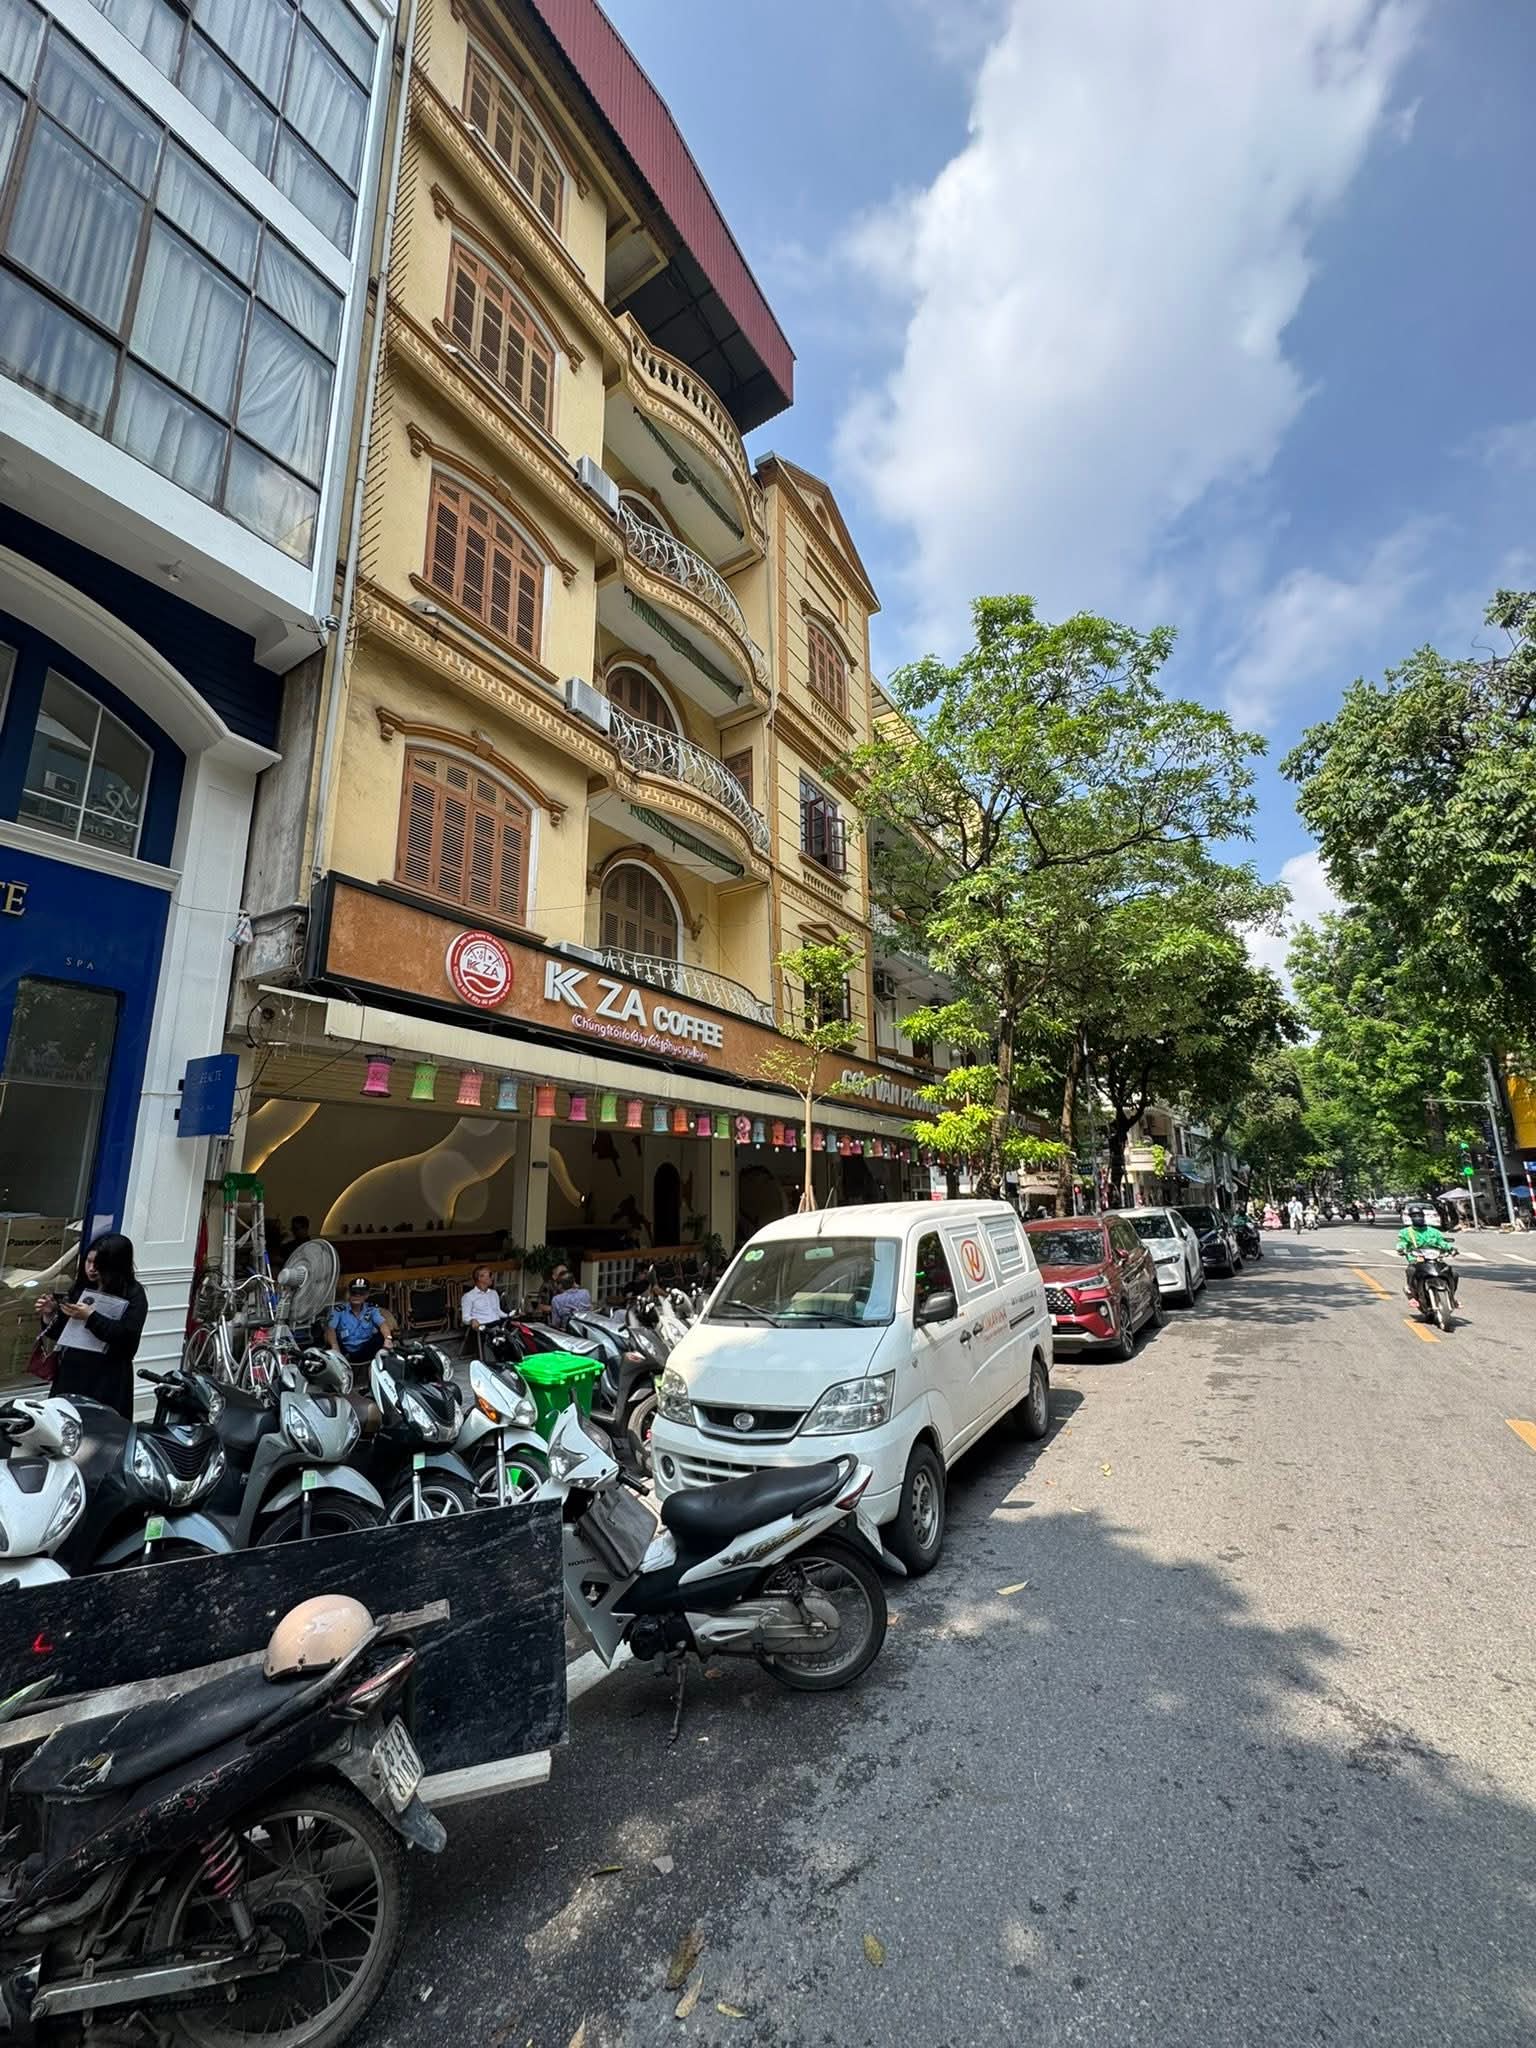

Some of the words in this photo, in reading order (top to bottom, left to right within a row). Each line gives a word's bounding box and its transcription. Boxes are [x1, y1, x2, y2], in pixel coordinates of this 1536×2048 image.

[66, 957, 94, 970] SPA
[596, 978, 648, 1028] ZA
[653, 1006, 724, 1049] COFFEE
[8, 1238, 62, 1247] Panasonic
